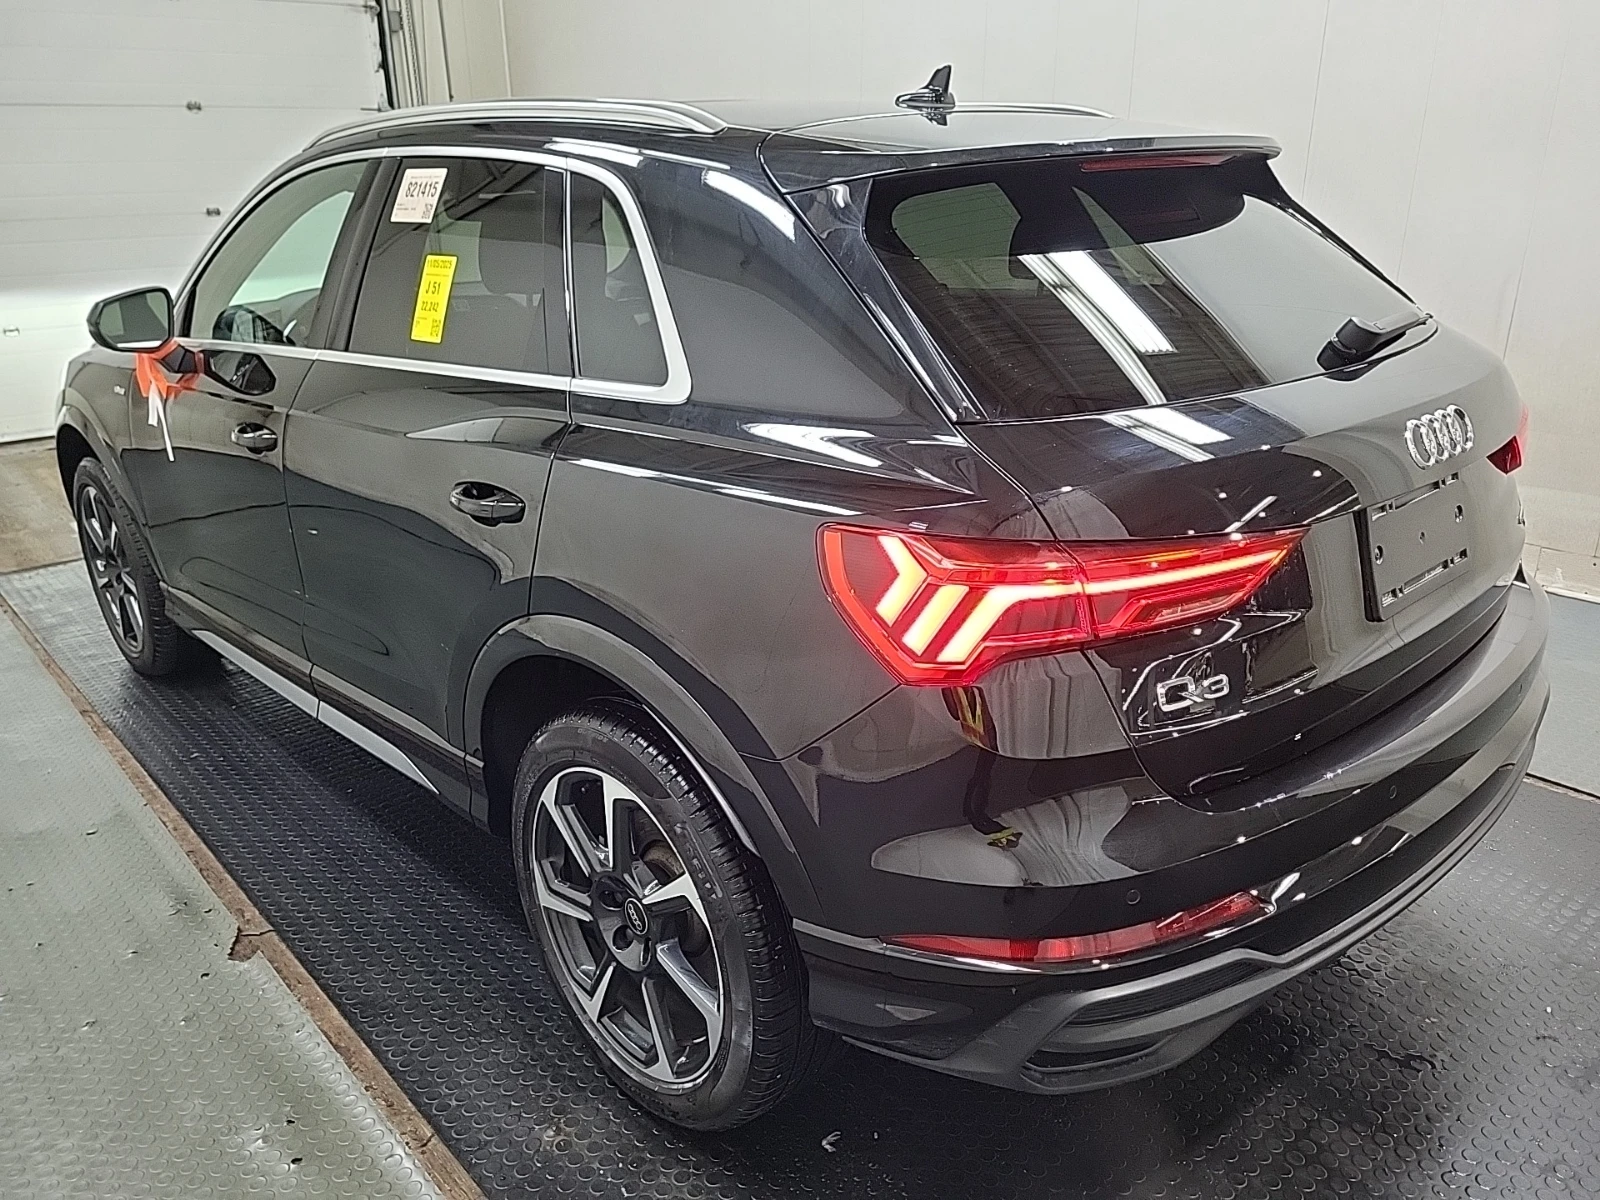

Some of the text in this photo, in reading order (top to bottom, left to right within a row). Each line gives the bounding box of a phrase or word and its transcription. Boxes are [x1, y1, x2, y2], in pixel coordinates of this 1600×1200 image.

[405, 181, 439, 198] 821415
[425, 280, 442, 295] J 51
[1156, 674, 1230, 712] Q3
